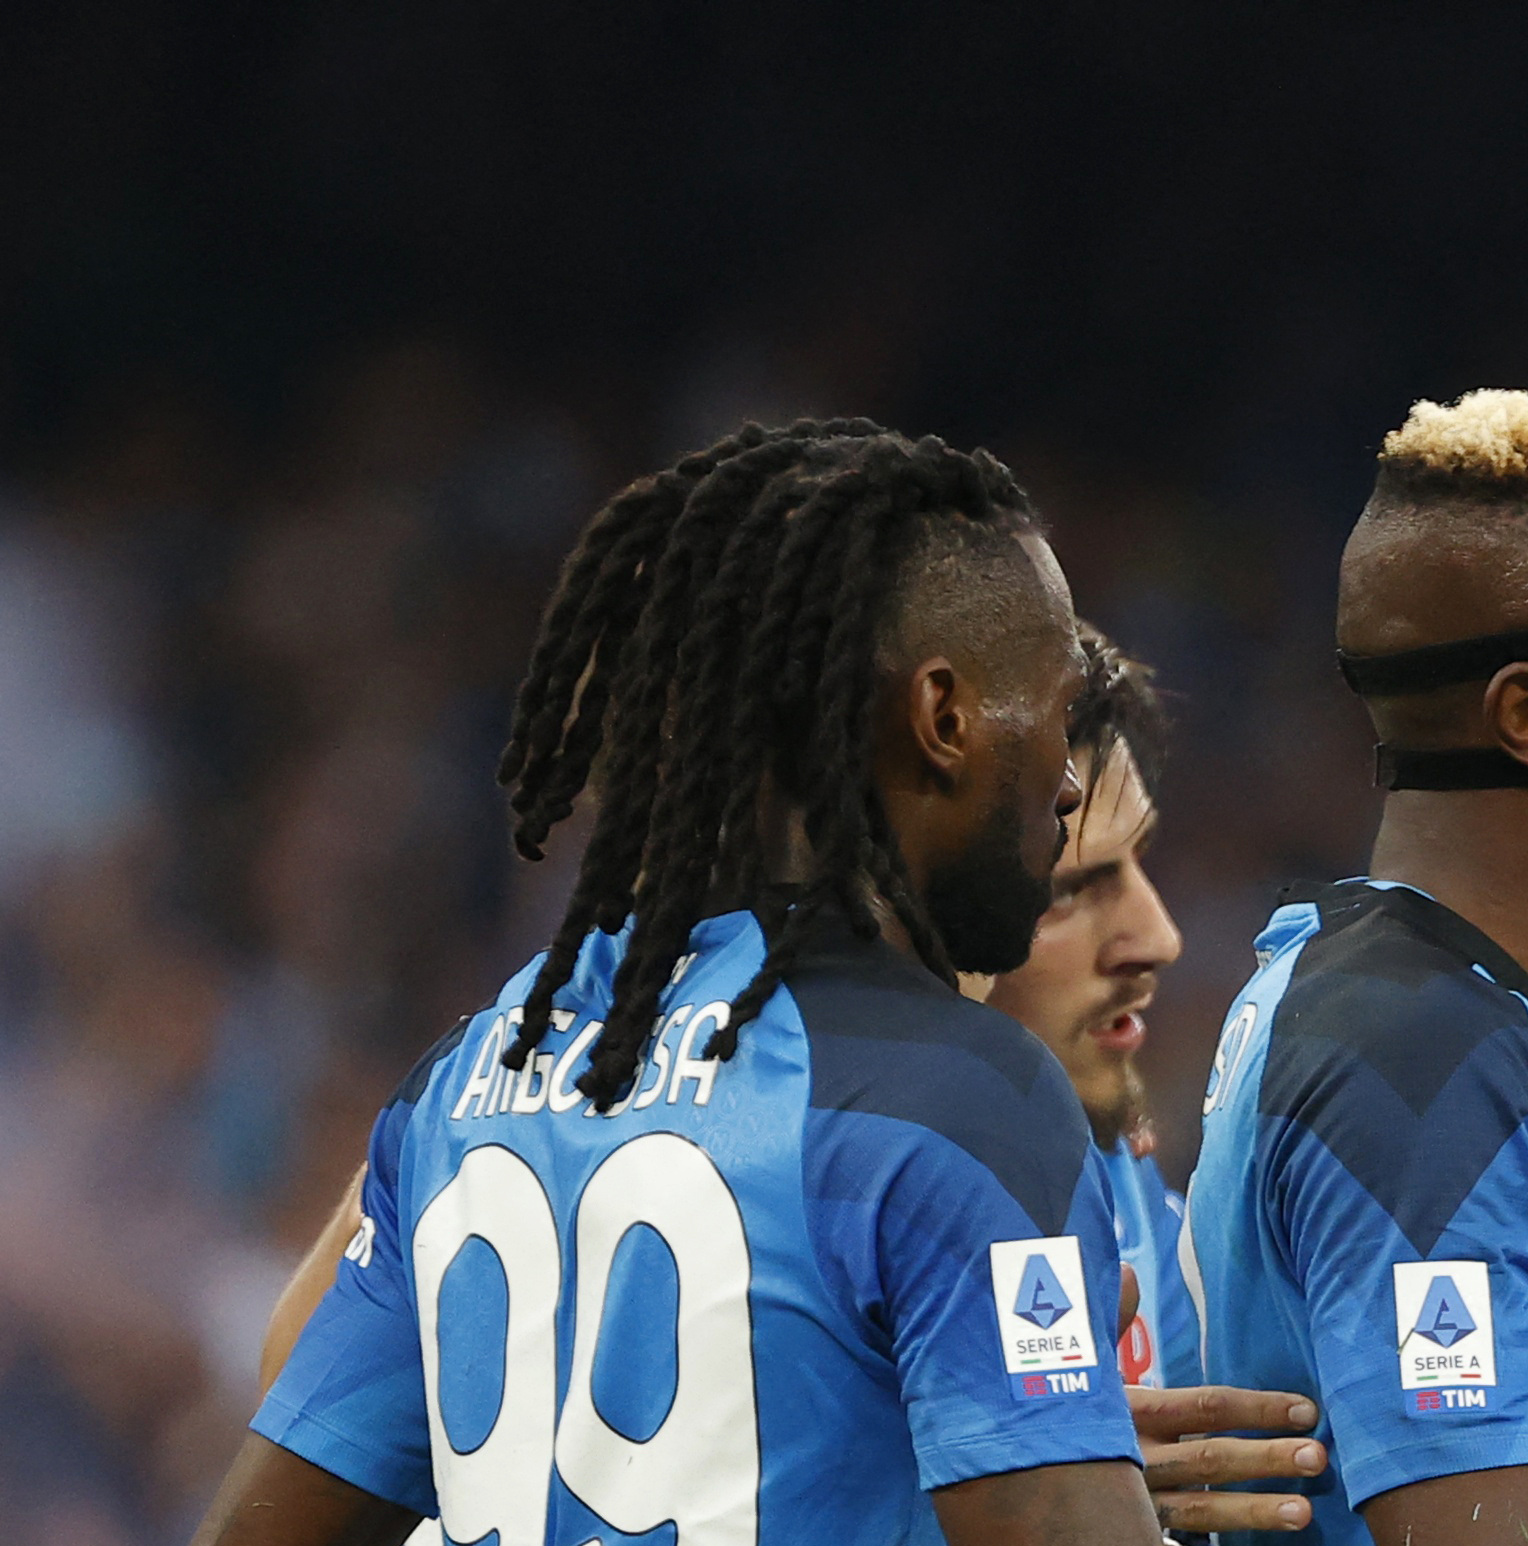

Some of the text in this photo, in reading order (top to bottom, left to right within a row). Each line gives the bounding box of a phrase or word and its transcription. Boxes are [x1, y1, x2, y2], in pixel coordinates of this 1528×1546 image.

[1016, 1335, 1080, 1354] SERIE A
[1414, 1355, 1480, 1371] SERIE A
[1046, 1371, 1089, 1393] TIM
[1441, 1389, 1487, 1409] TIM
